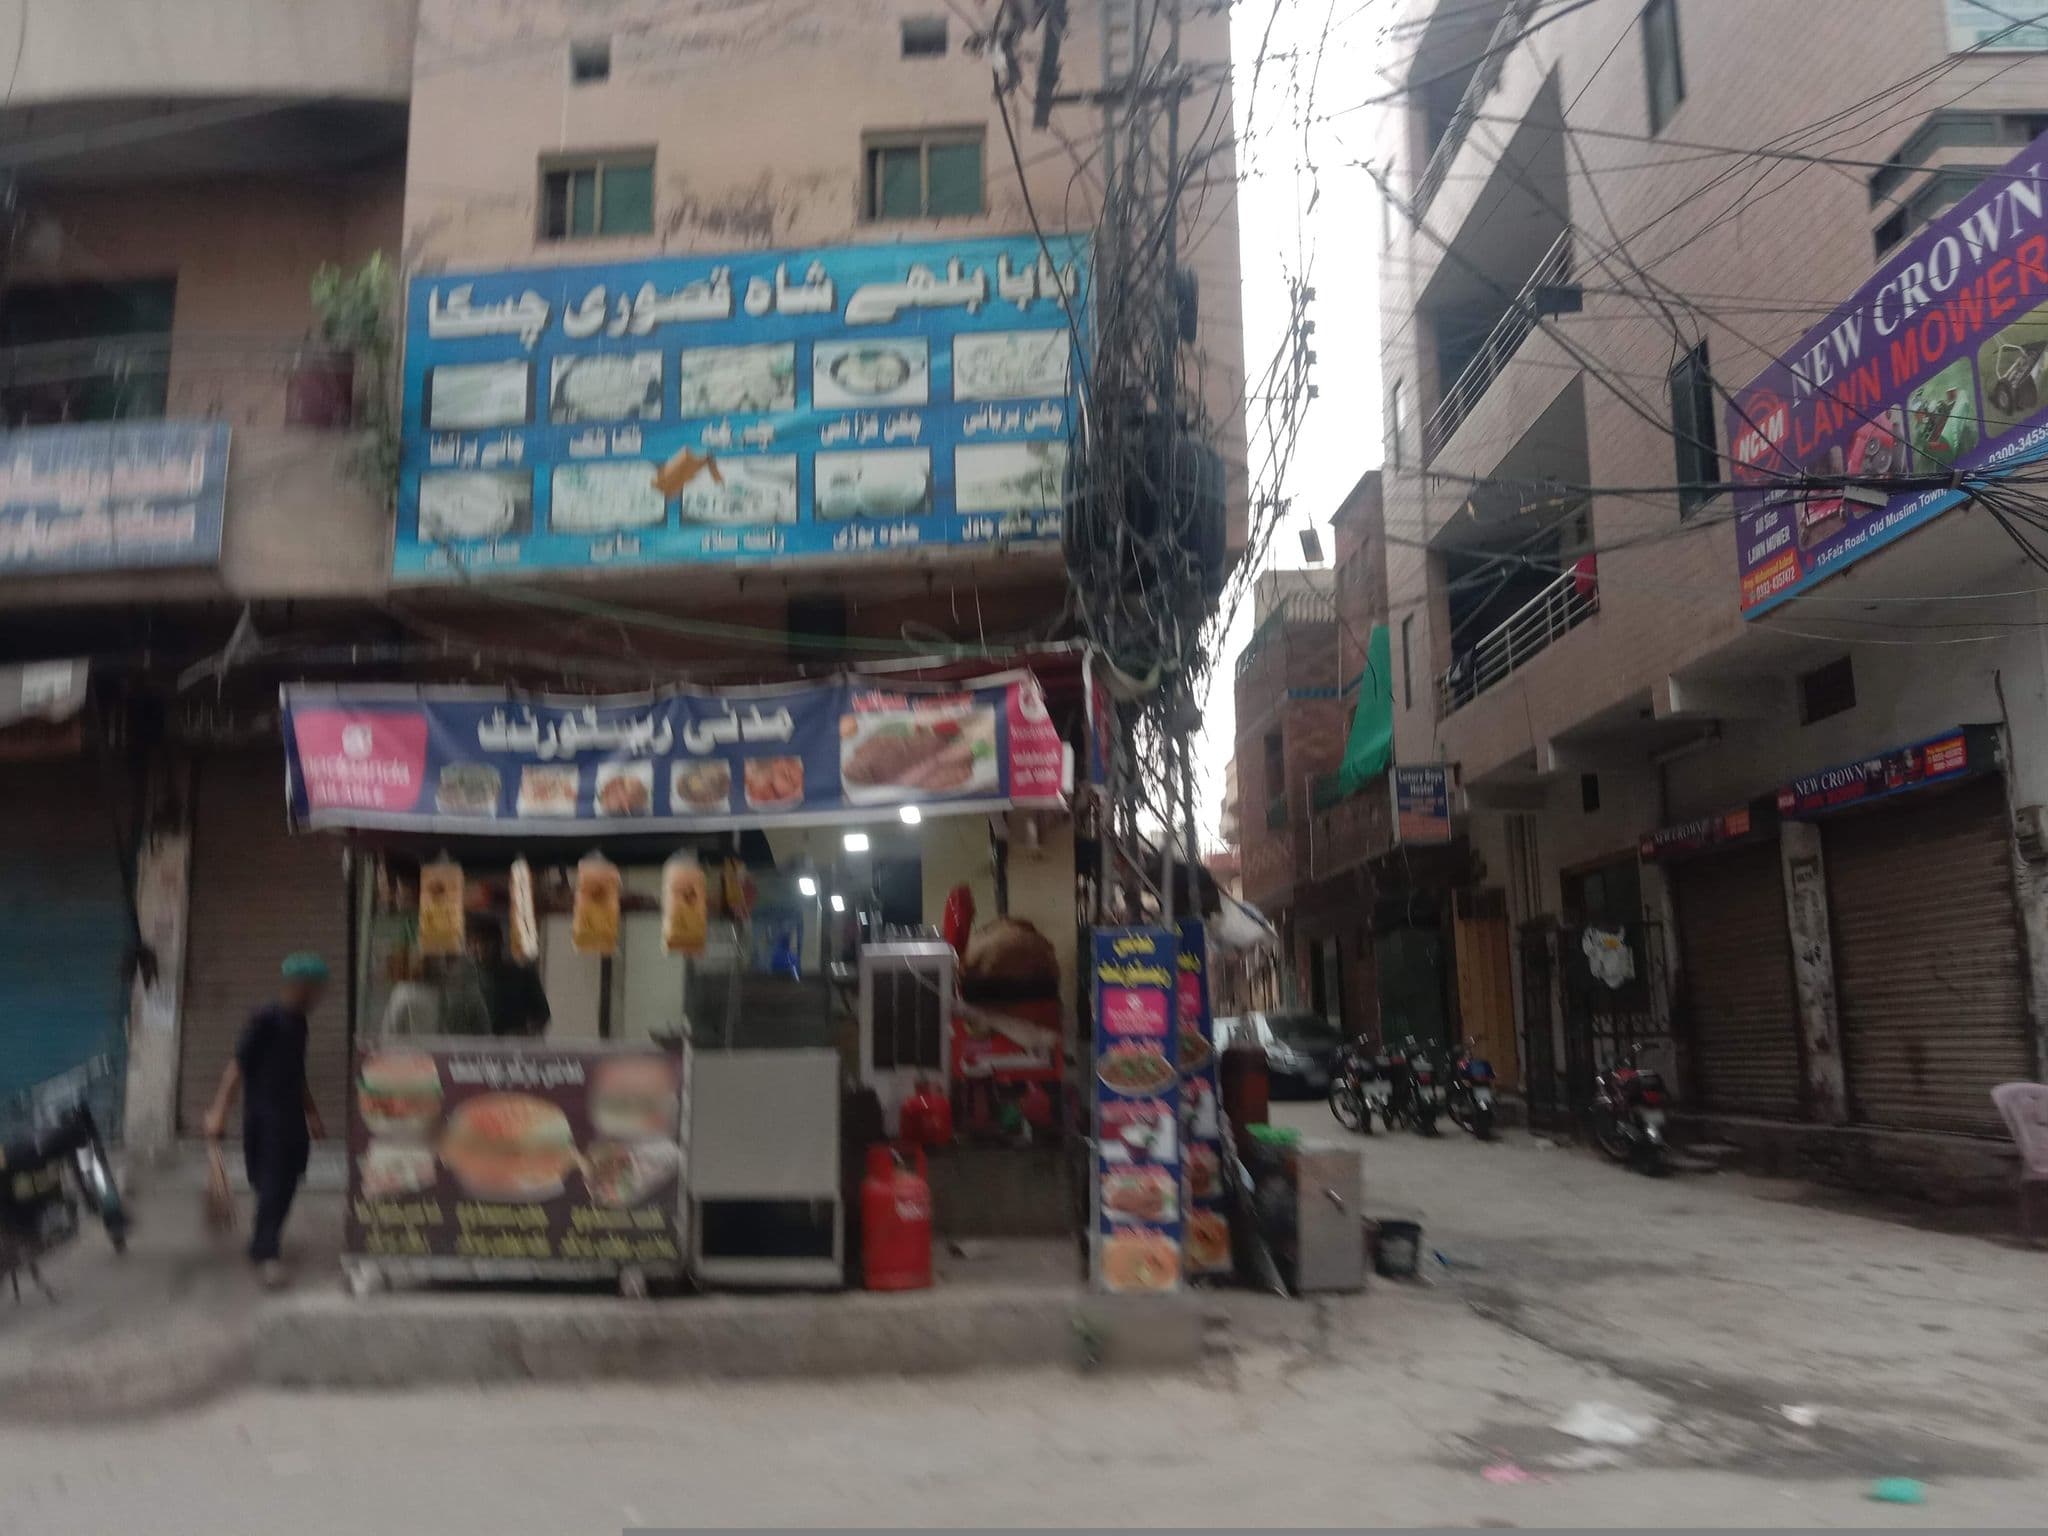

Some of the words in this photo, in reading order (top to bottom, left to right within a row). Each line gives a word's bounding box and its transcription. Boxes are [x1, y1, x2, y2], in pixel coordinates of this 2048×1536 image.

[563, 264, 731, 339] قصوری
[744, 258, 833, 317] شاہ
[998, 250, 1075, 311] بابا
[1790, 307, 1864, 408] NEW
[1873, 162, 2043, 336] CROWN
[429, 282, 549, 350] چسکا
[1795, 356, 1881, 457] LAWN
[1890, 234, 2048, 388] MOWER
[1738, 408, 1784, 464] NCLM
[1817, 545, 1843, 567] 13-Faiz
[1844, 530, 1868, 550] Road,
[1869, 518, 1885, 537] Old
[1886, 500, 1917, 528] Muslim
[1795, 779, 1818, 797] NEW
[1821, 763, 1867, 790] CROWN
